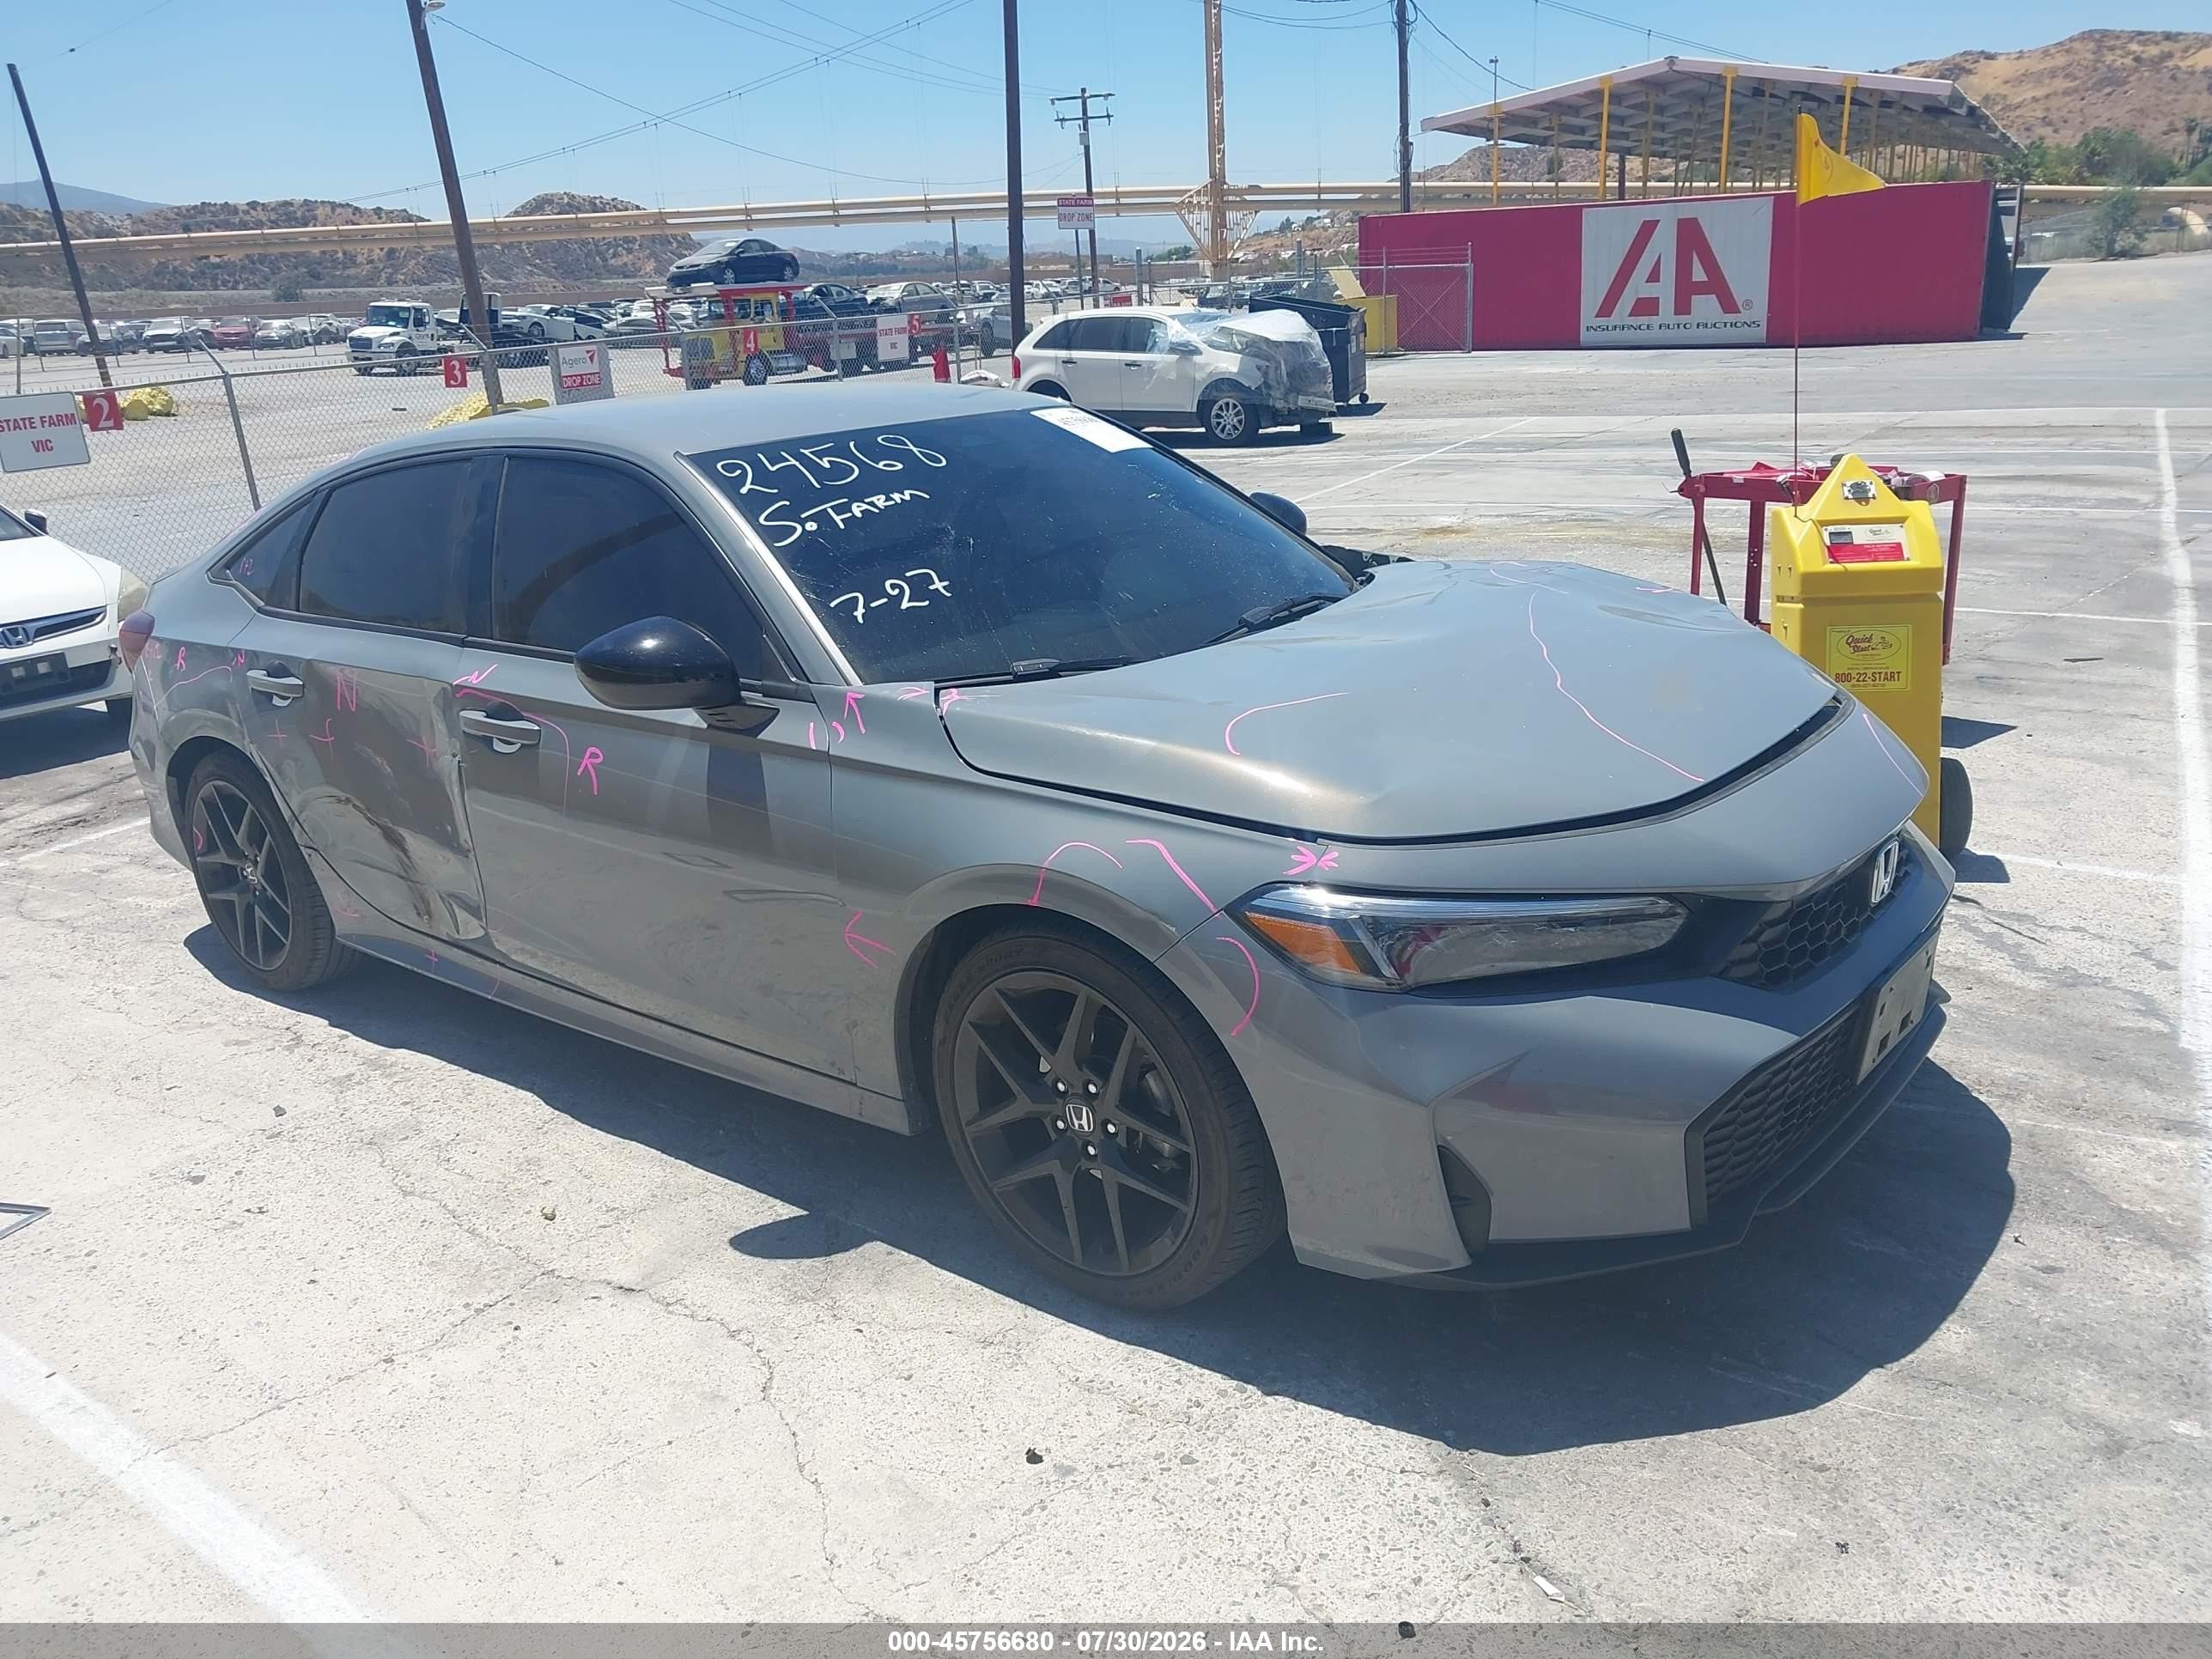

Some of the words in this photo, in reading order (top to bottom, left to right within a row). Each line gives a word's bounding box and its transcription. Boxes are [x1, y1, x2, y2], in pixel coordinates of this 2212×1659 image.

[1059, 212, 1076, 222] DROP
[1077, 212, 1093, 222] ZONE
[911, 314, 920, 333] 5
[1586, 322, 1655, 333] INSURANCE
[1658, 322, 1692, 331] AUTO
[1696, 320, 1761, 330] AUCTIONS
[878, 328, 894, 337] STATE
[746, 330, 756, 352] 4
[562, 356, 587, 369] Agero
[448, 359, 463, 386] 3
[562, 375, 582, 388] DROP
[582, 373, 601, 386] ZONE
[40, 412, 78, 428] FARM
[92, 397, 115, 428] 2
[30, 438, 54, 453] VIC
[716, 434, 947, 495] 24568
[829, 568, 953, 624] 7-27
[1844, 633, 1874, 646] Quick
[1834, 671, 1902, 684] 800-22-START
[336, 669, 358, 712] N
[577, 745, 605, 796] R
